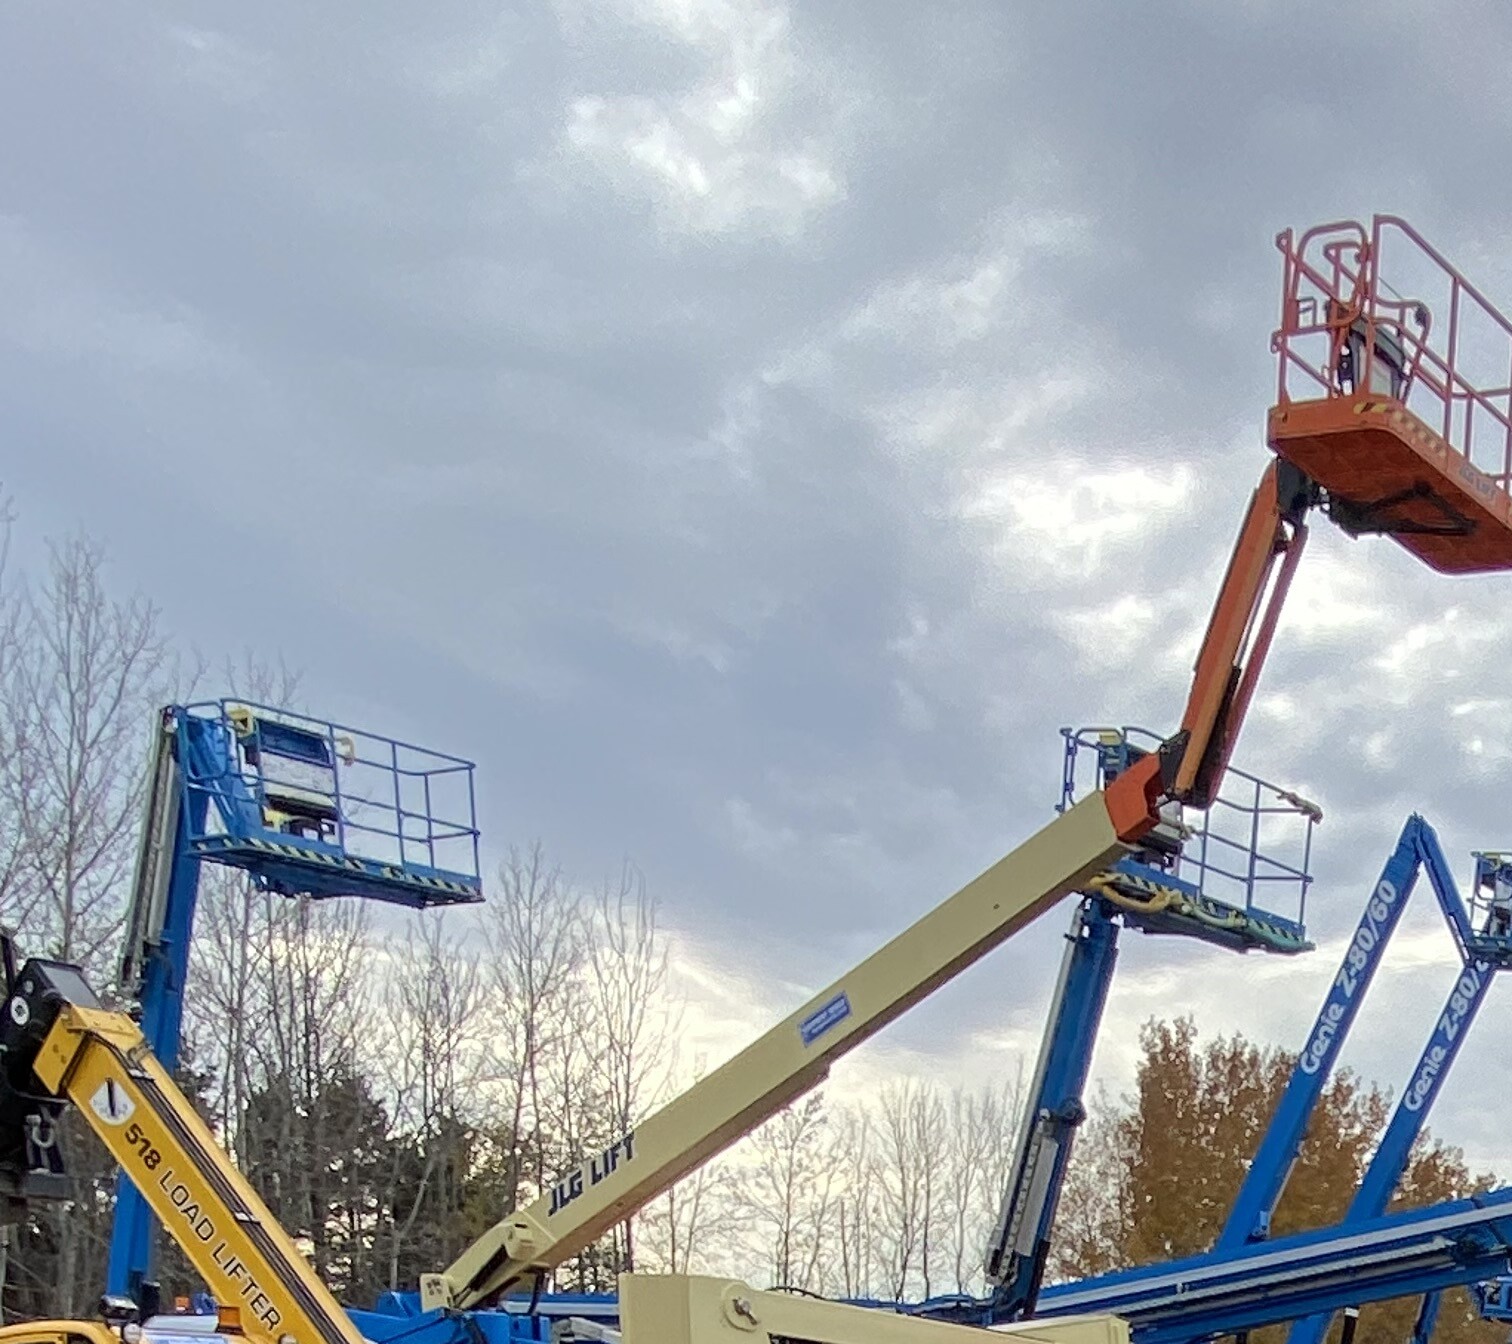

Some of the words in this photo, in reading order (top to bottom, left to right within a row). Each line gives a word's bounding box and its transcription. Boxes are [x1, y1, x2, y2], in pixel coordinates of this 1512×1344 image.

[1301, 1003, 1345, 1075] Genie
[1335, 879, 1397, 998] Z-80/60
[1404, 1045, 1446, 1111] Genie
[1438, 959, 1490, 1042] Z-80/
[125, 1123, 162, 1171] 518
[159, 1170, 215, 1242] LOAD
[212, 1243, 282, 1331] LIFTER
[548, 1170, 583, 1217] JLG
[591, 1131, 634, 1185] LIFT
